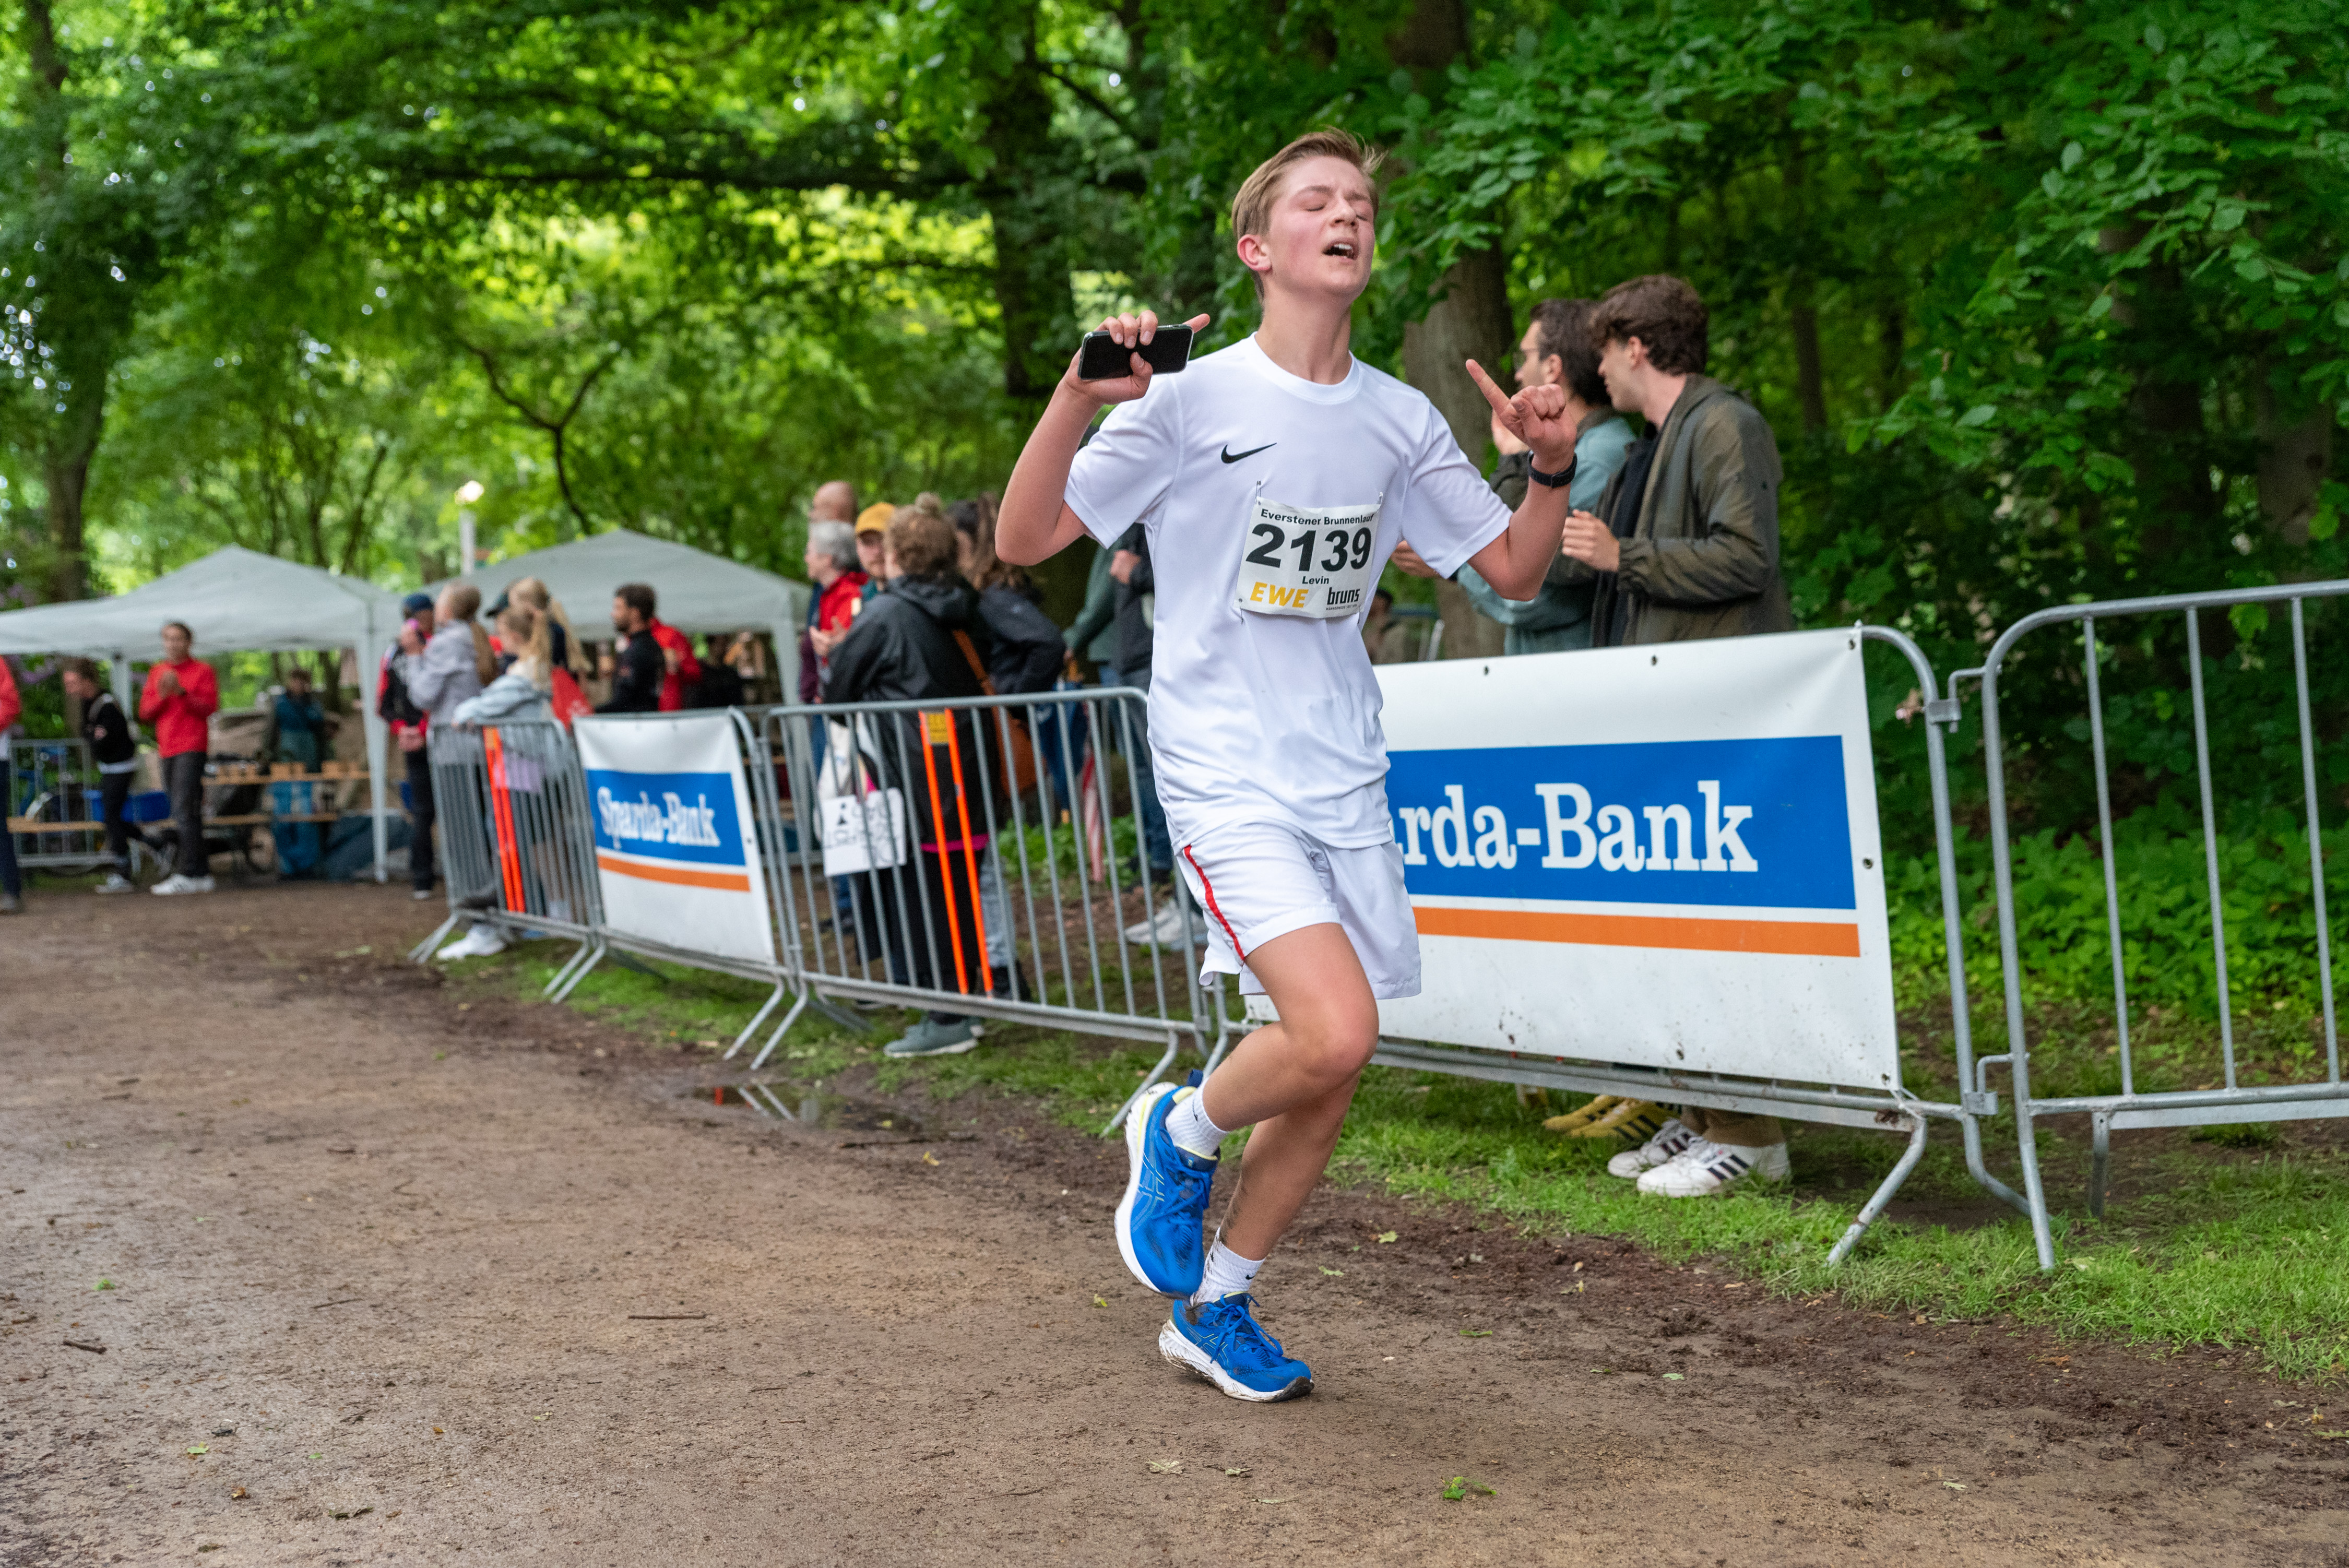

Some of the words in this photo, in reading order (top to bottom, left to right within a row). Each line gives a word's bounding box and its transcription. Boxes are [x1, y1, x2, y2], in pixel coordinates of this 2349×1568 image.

[1261, 508, 1321, 525] Everstener
[1324, 514, 1374, 525] Brunnenlauf
[1245, 523, 1371, 572] 2139
[1302, 576, 1330, 585] Levin
[1250, 581, 1309, 608] EWE
[1327, 587, 1360, 605] bruns
[597, 786, 721, 850] Sparda-Bank
[1387, 780, 1758, 872] rda-Bank
